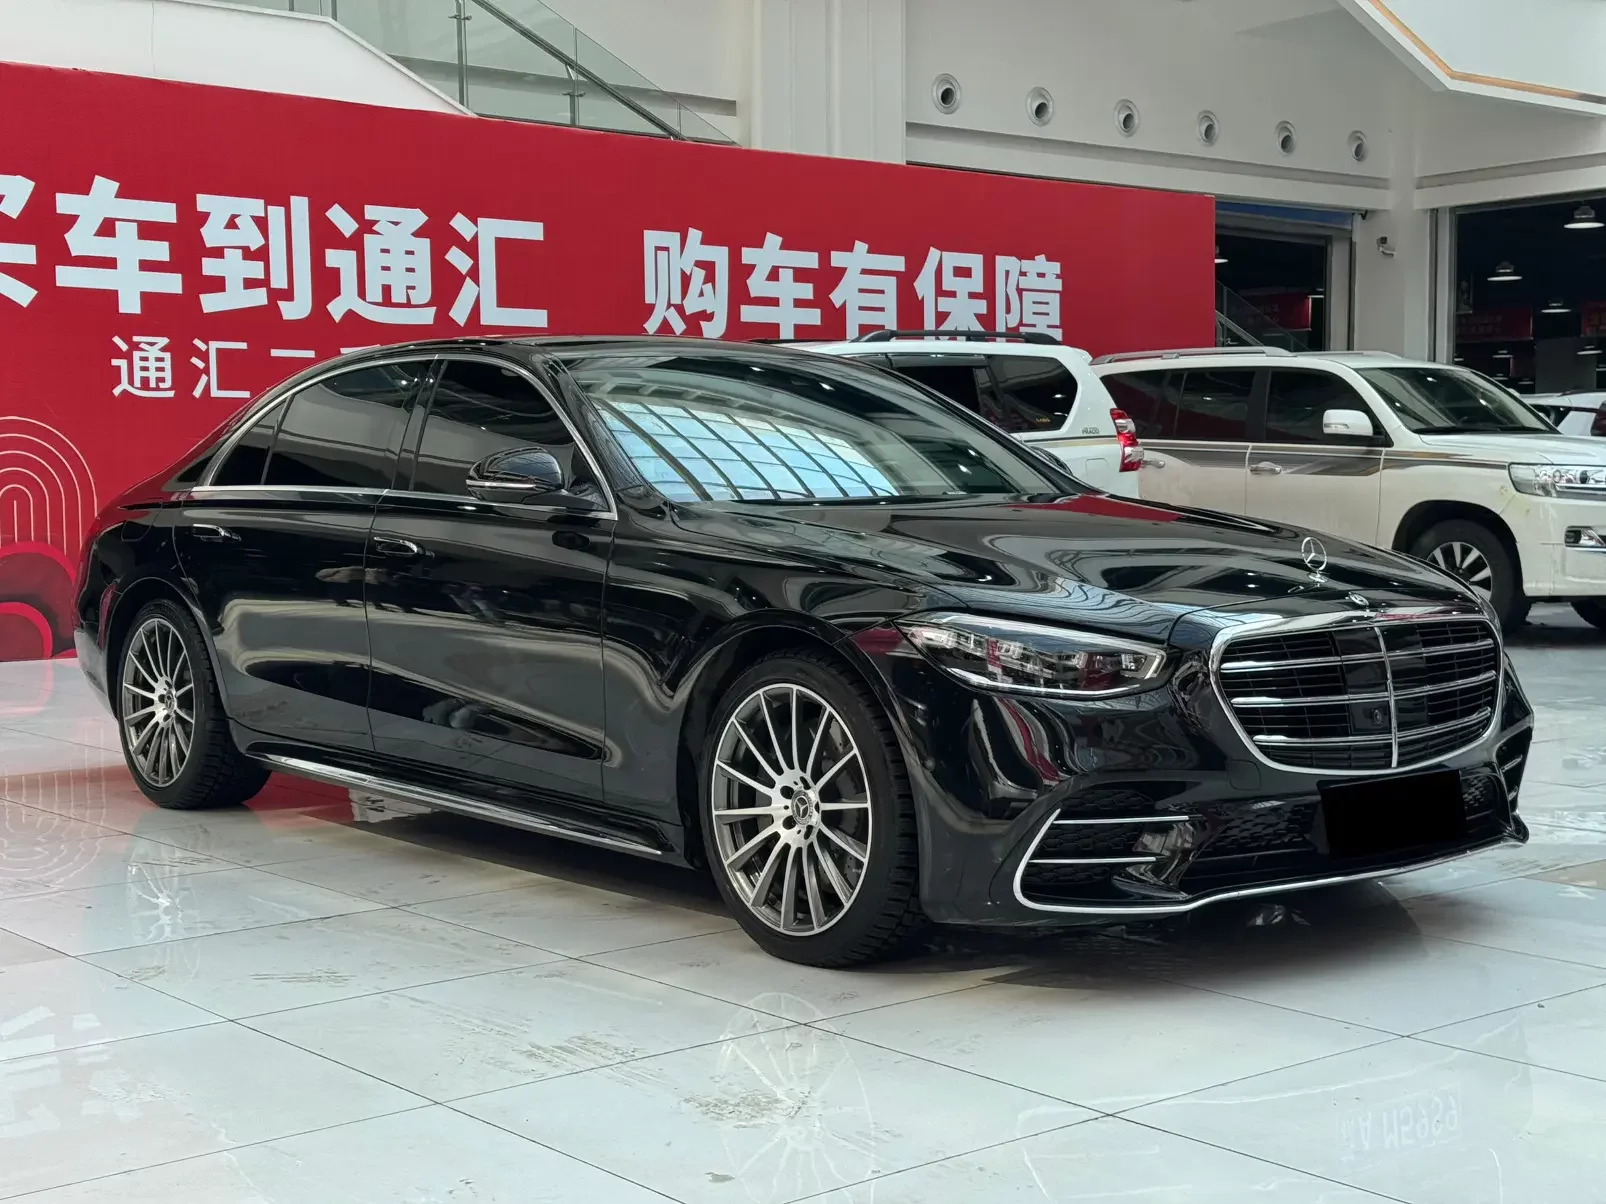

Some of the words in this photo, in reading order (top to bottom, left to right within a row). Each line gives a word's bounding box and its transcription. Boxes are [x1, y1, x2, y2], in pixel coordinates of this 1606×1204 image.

[643, 227, 1063, 342] 购车有保障
[111, 335, 380, 398] 通汇
